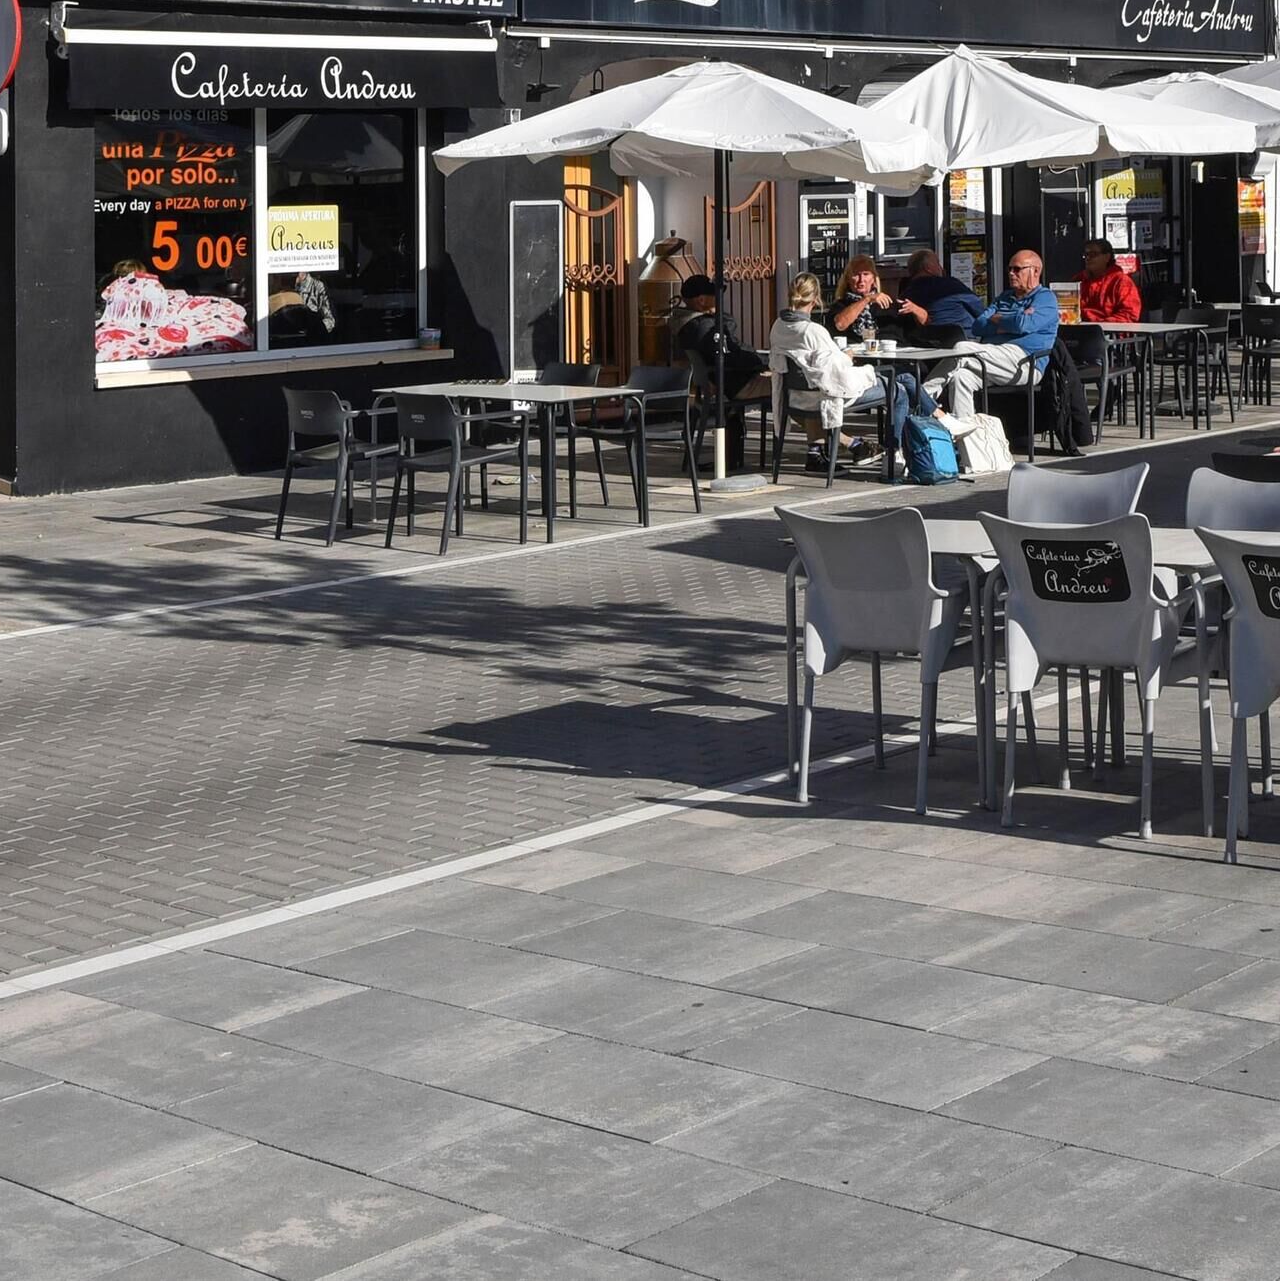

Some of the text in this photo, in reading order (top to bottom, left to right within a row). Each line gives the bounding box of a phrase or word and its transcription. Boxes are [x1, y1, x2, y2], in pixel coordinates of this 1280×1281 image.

[170, 52, 417, 105] Cafetería Andreu
[102, 131, 236, 164] una Pizza
[127, 168, 165, 191] por
[94, 200, 127, 214] Every
[130, 199, 151, 213] day
[155, 201, 162, 210] a
[166, 198, 200, 209] PIZZA
[204, 197, 220, 208] for
[152, 220, 180, 271] 5
[1045, 569, 1110, 594] Andreu
